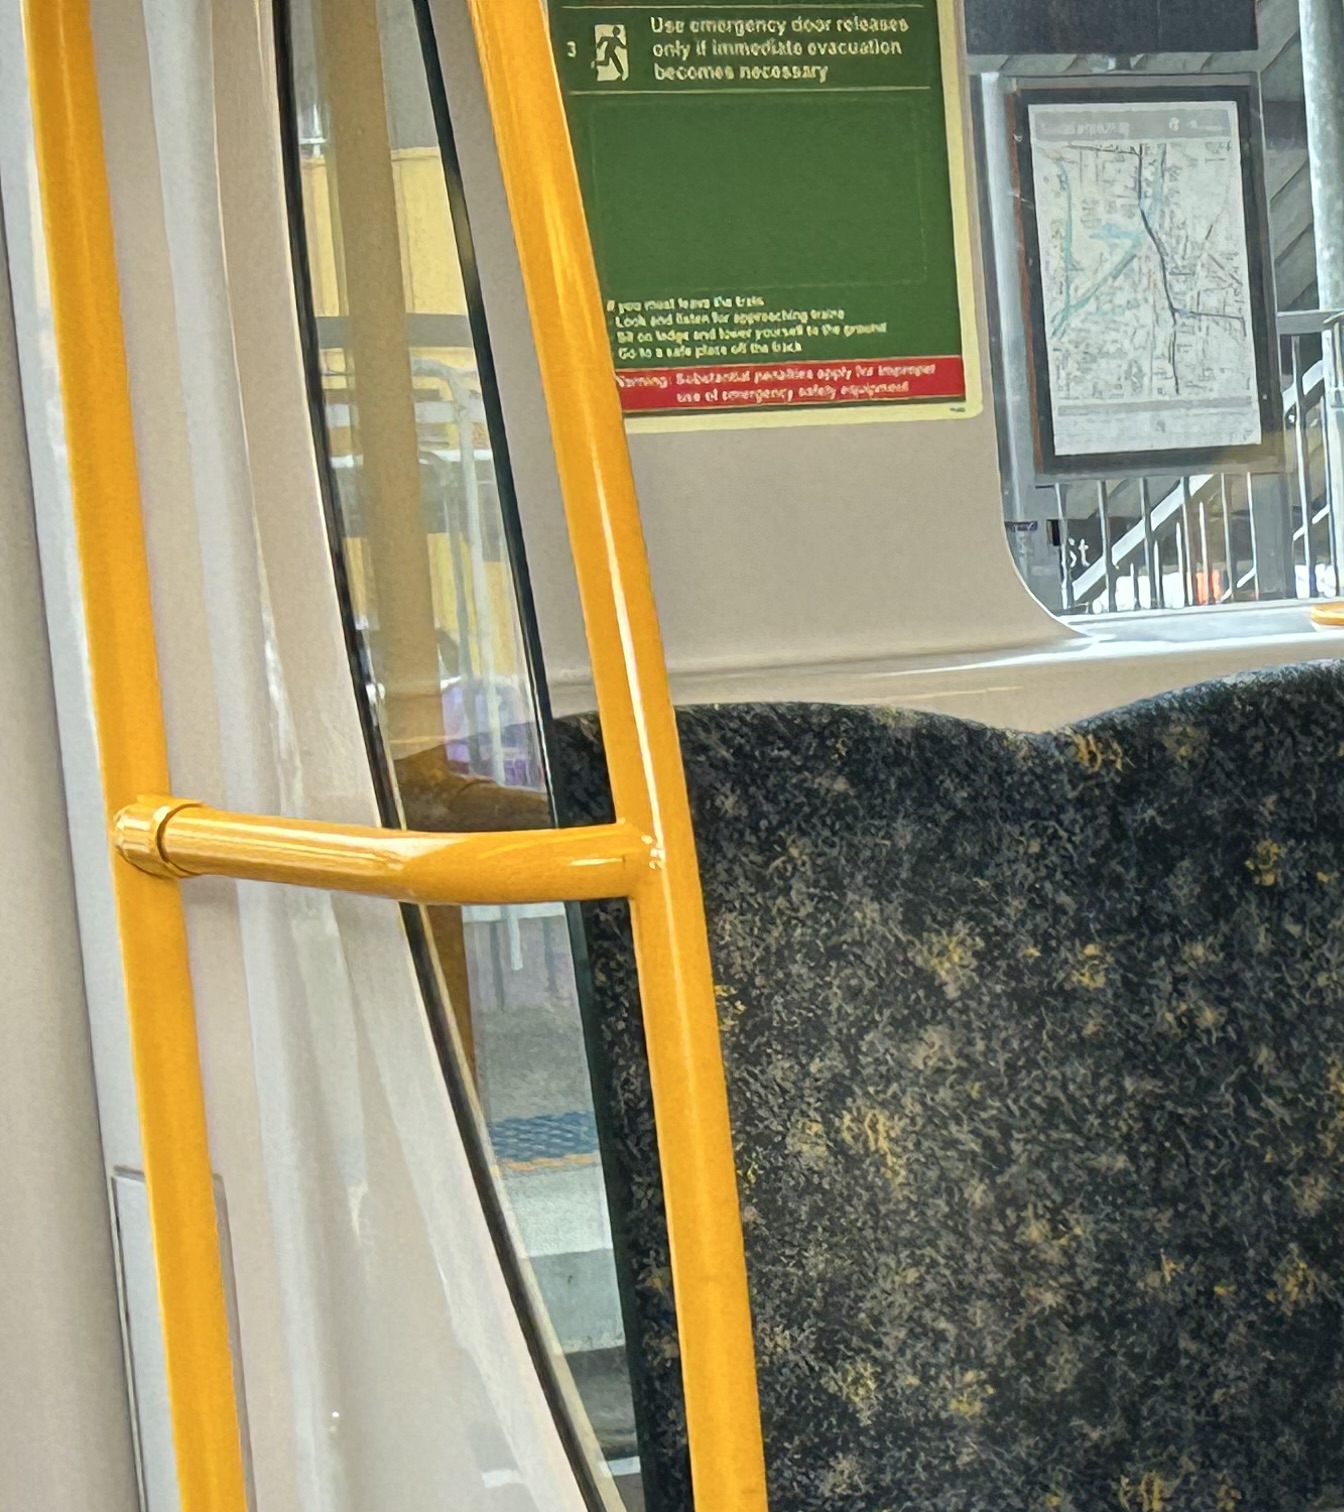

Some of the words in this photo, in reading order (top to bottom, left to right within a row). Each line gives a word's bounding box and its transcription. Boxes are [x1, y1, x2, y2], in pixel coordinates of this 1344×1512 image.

[650, 16, 685, 34] Use
[689, 17, 787, 37] emergency
[791, 15, 832, 33] door
[836, 14, 910, 33] releases
[566, 40, 577, 58] 3
[652, 39, 691, 62] only
[695, 39, 707, 57] if
[712, 38, 803, 57] immediate
[807, 37, 903, 56] evacuation
[653, 62, 735, 81] becomes
[739, 65, 829, 84] necessary
[618, 301, 642, 315] you
[615, 314, 647, 328] Look
[650, 314, 673, 327] and
[675, 312, 710, 325] listen
[711, 311, 730, 324] for
[733, 309, 809, 326] approaching
[693, 328, 716, 341] and
[718, 327, 752, 340] lower
[617, 347, 637, 360] Go
[694, 345, 728, 359] place
[750, 341, 769, 355] the
[675, 371, 751, 385] Substantial
[816, 364, 852, 381] apply
[855, 363, 874, 378] for
[877, 363, 936, 378] improper
[721, 388, 794, 403] emergency
[798, 383, 837, 400] safety
[840, 380, 910, 400] equipment
